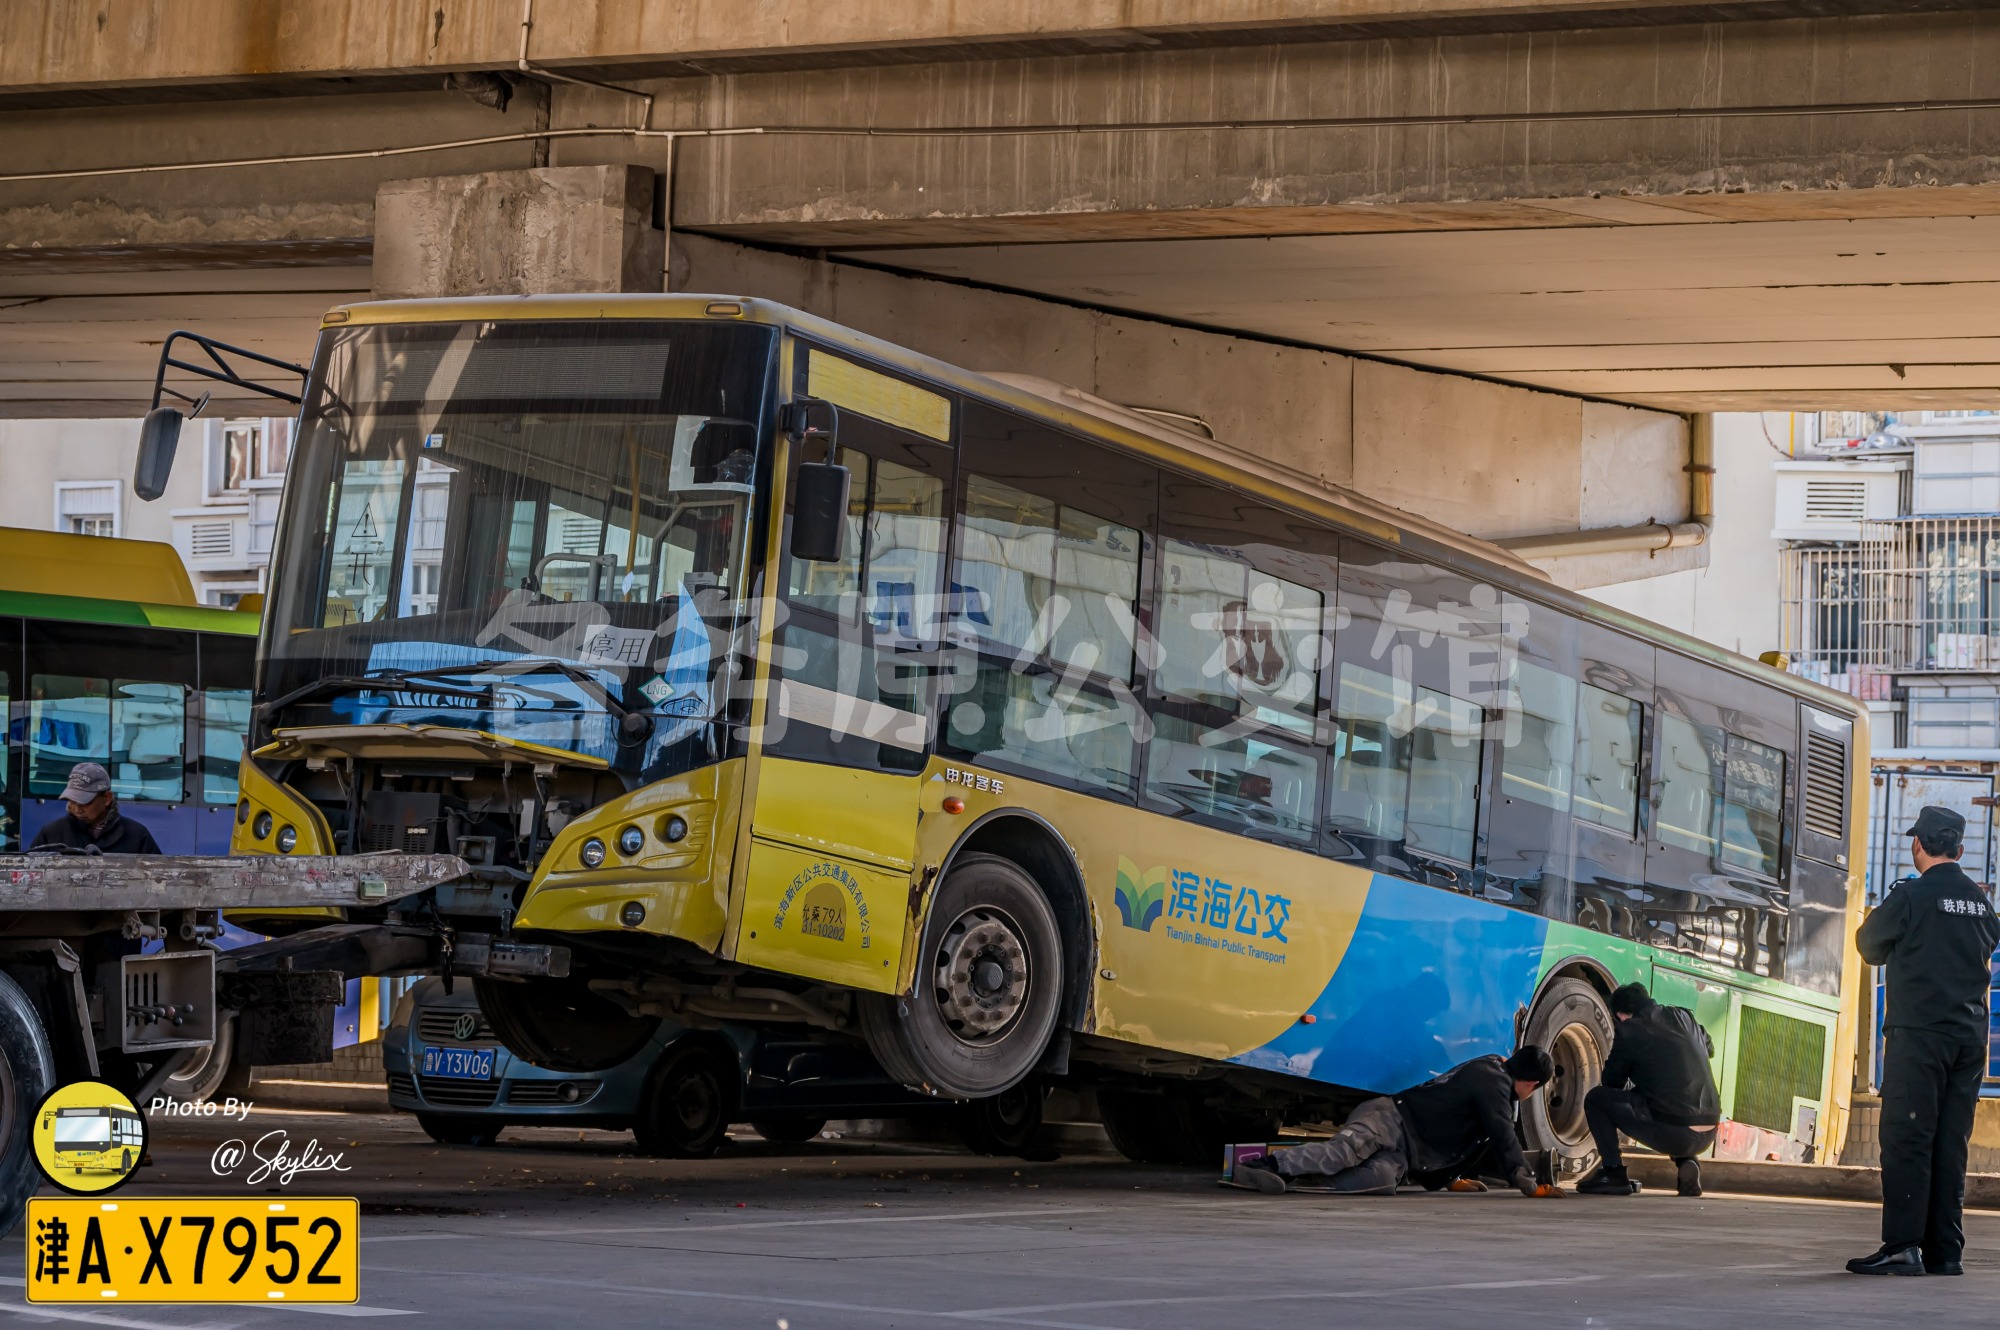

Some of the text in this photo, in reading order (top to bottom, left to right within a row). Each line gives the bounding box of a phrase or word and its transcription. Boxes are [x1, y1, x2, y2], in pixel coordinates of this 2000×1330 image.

[587, 632, 646, 664] 停用
[646, 684, 668, 696] LNG
[945, 767, 1004, 795] 申龙客车
[773, 862, 871, 949] 滨海新区公共交通集团有限公司
[1167, 868, 1292, 944] 滨海公交
[1943, 898, 1986, 916] 秩序维护
[1166, 925, 1287, 965] Tianjin Binhai Public Transport
